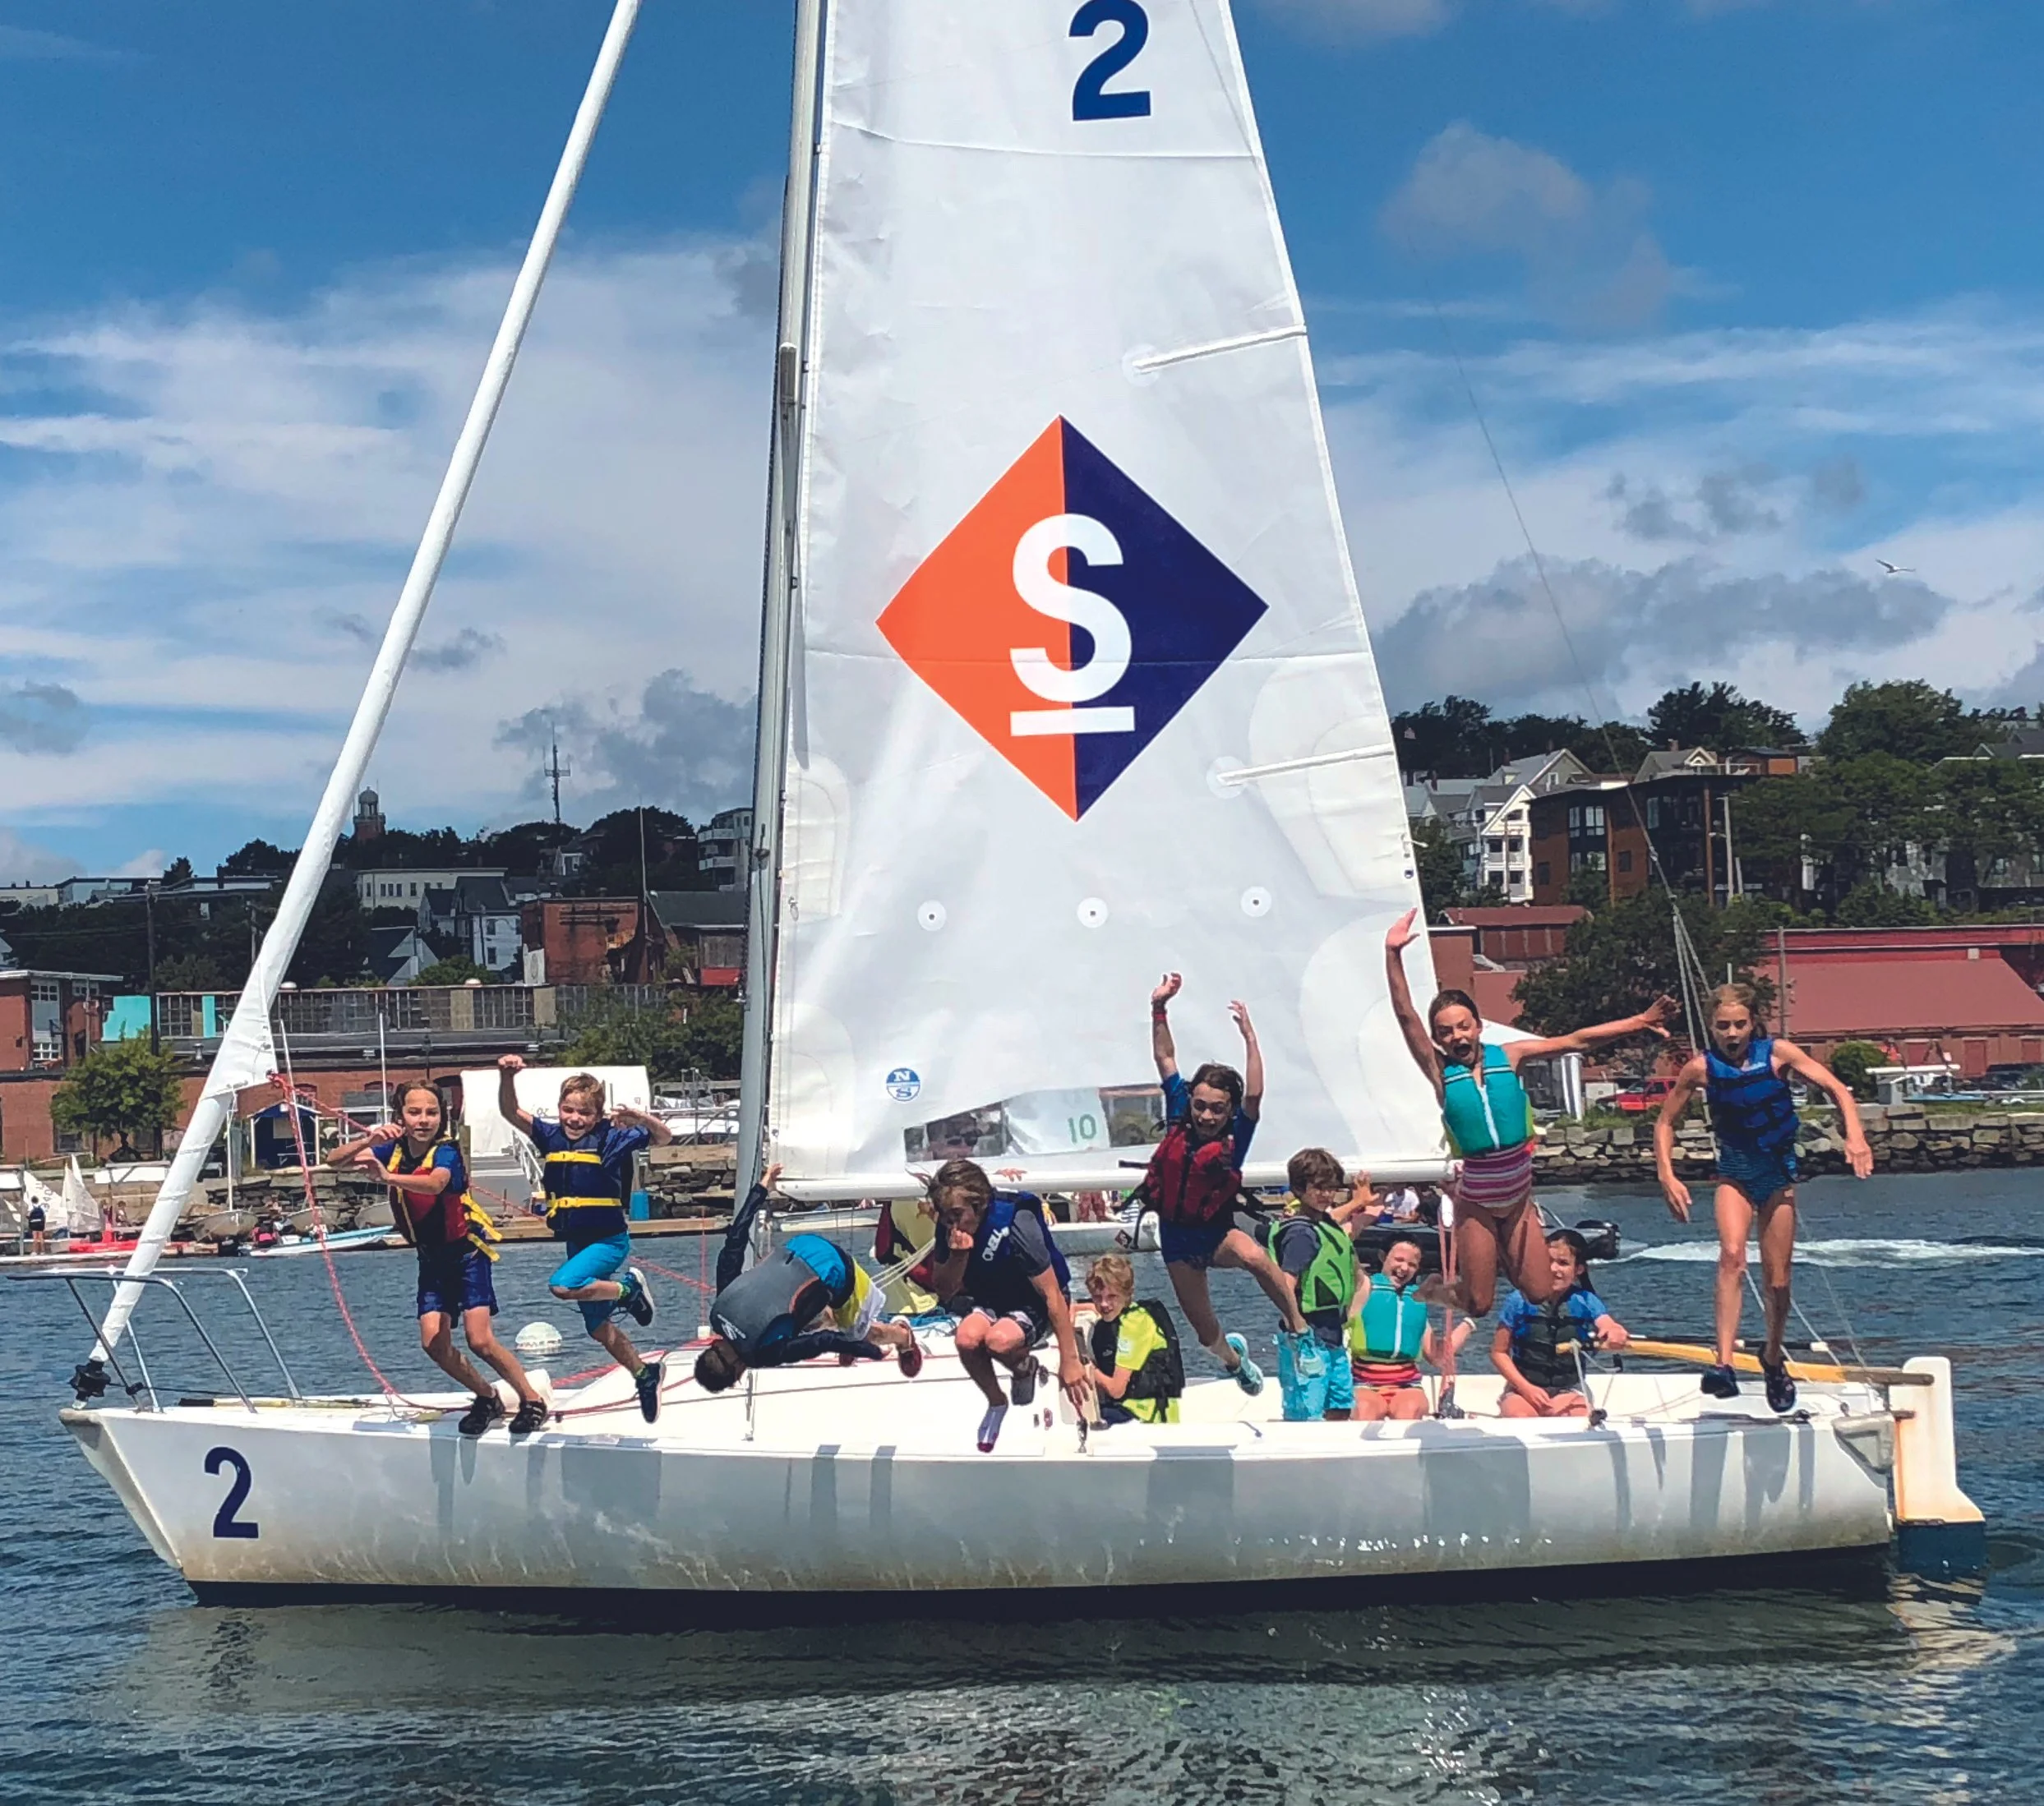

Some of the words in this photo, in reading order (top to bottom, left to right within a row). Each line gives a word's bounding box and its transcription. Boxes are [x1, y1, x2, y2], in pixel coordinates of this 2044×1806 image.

[1068, 0, 1151, 121] 2
[1010, 514, 1132, 703] S
[894, 1071, 911, 1081] N
[1068, 1114, 1096, 1144] 10
[205, 1447, 259, 1538] 2
